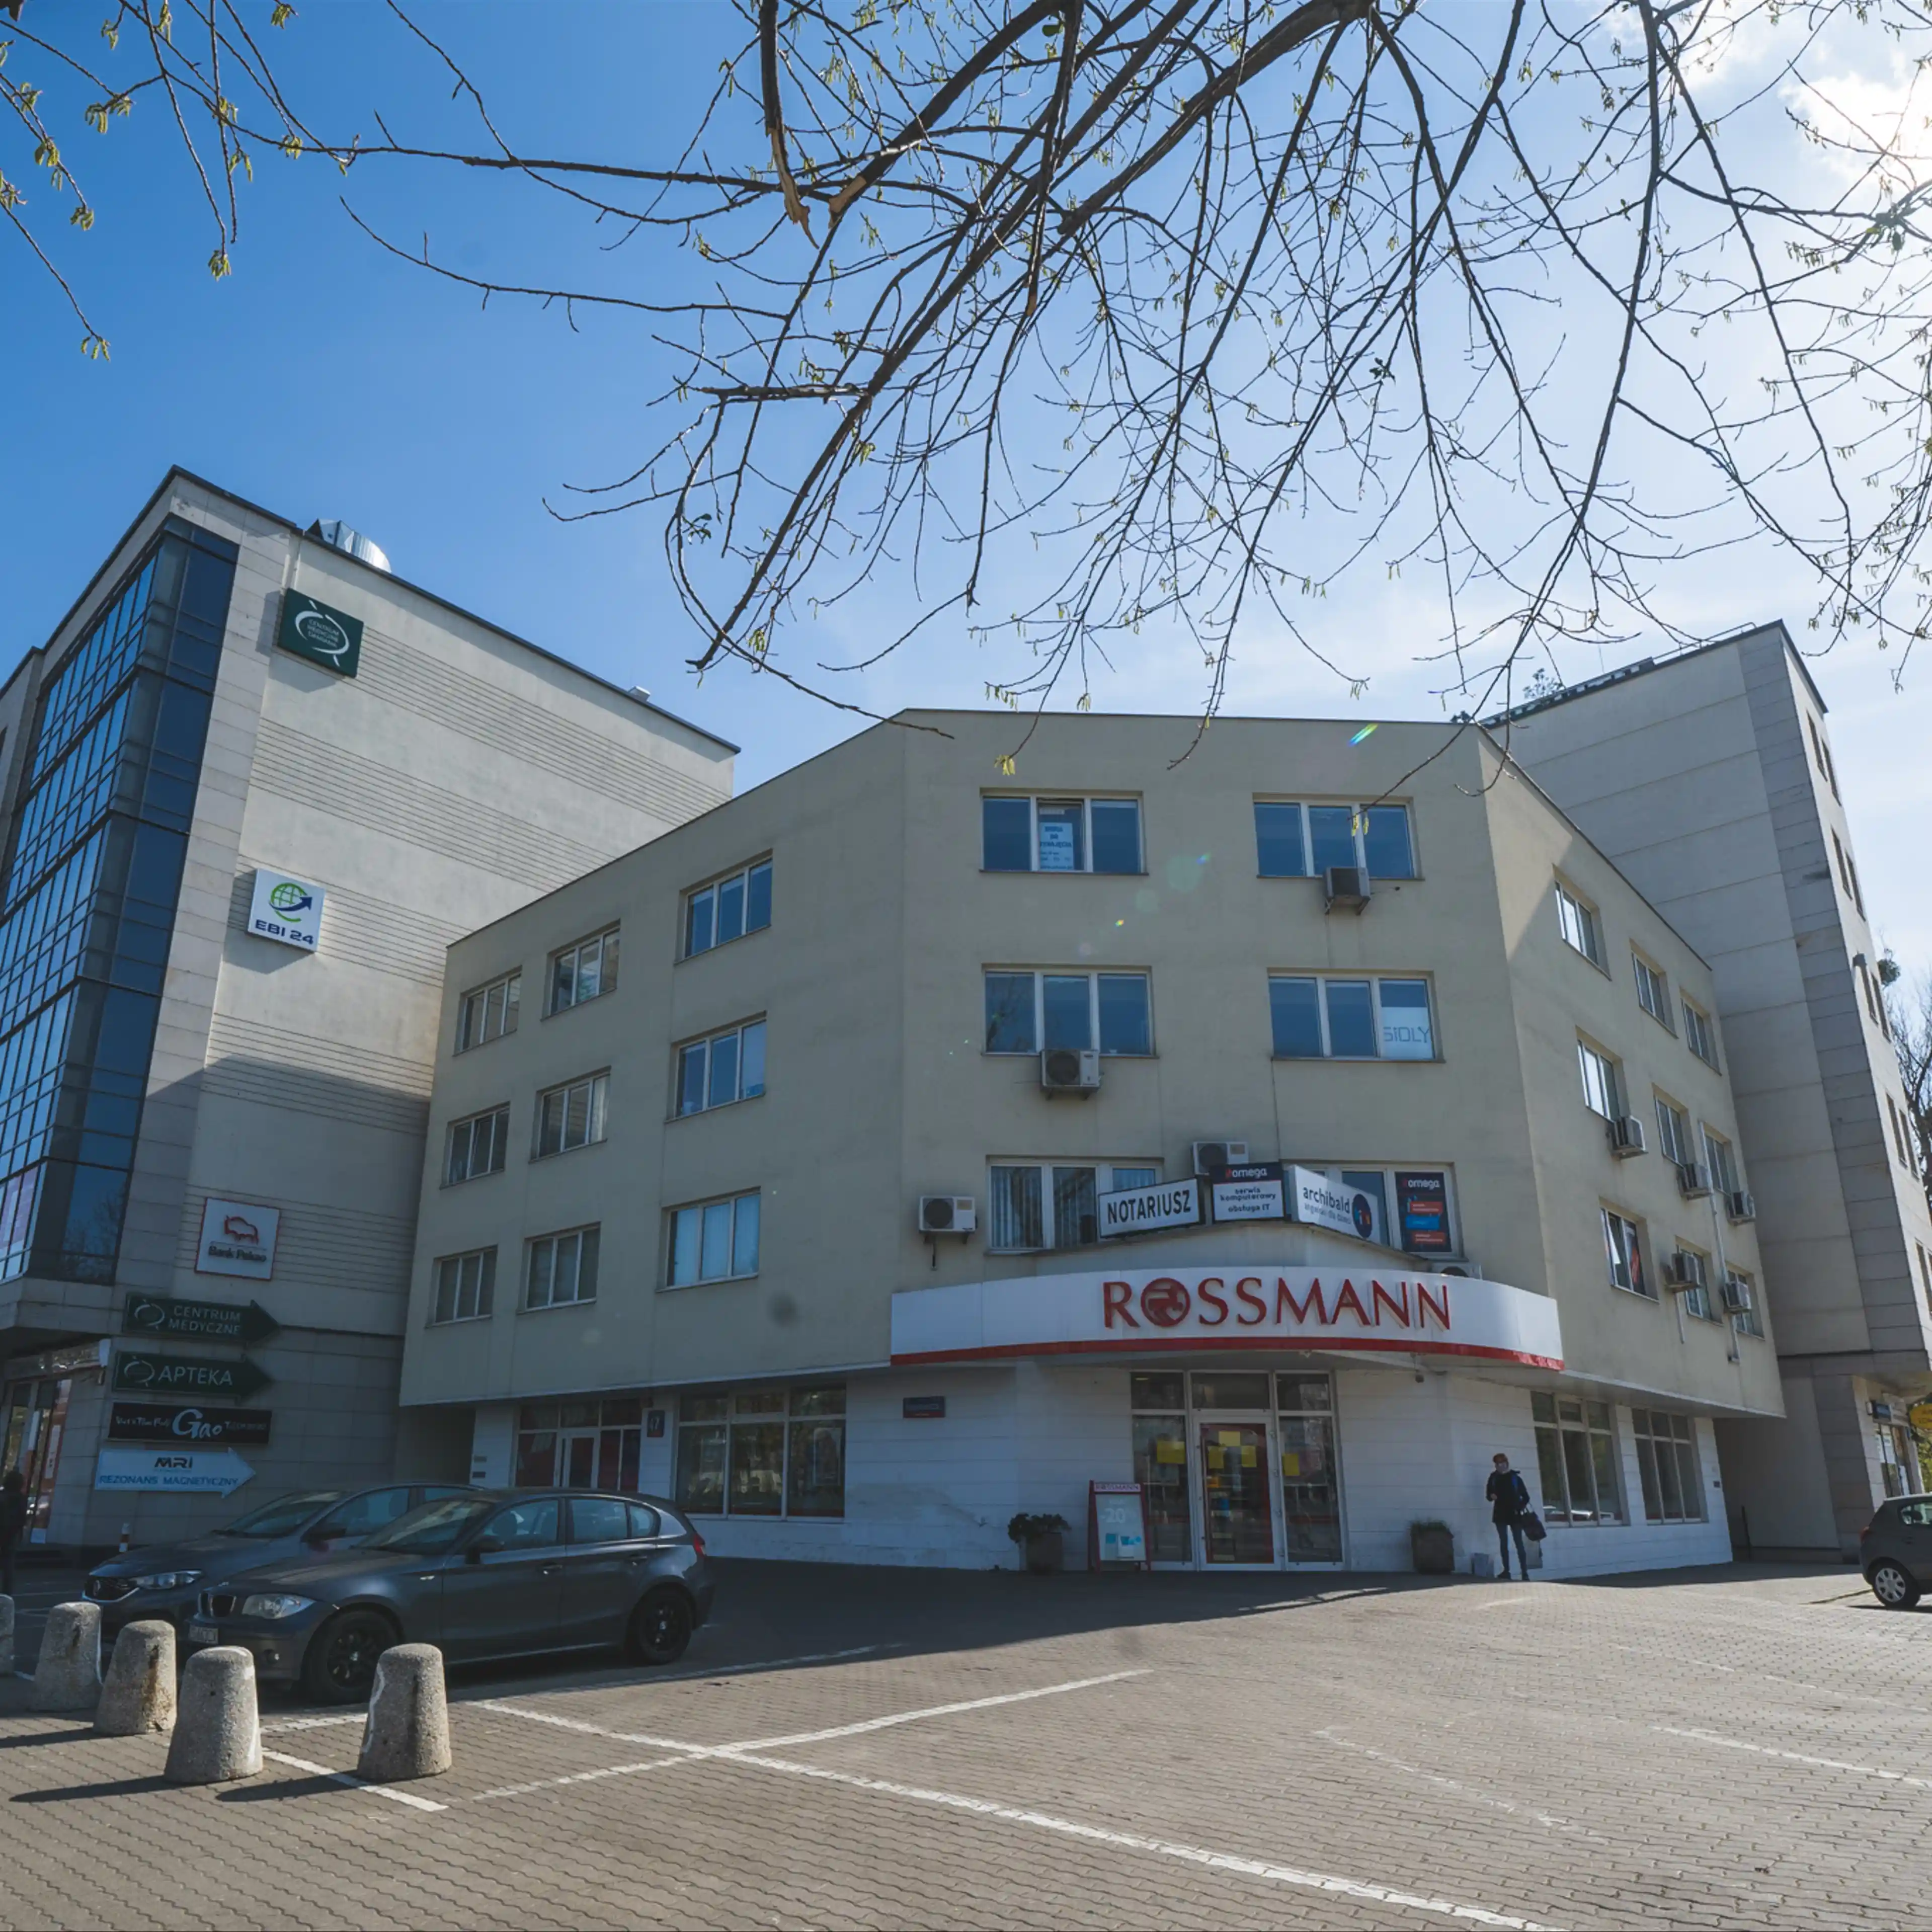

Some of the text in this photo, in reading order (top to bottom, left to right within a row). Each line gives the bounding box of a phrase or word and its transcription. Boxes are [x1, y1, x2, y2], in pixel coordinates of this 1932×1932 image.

[255, 919, 314, 945] EBI 24
[1232, 1168, 1268, 1179] omega
[1408, 1179, 1440, 1190] omega
[1107, 1189, 1192, 1224] NOTARIUSZ
[1302, 1186, 1350, 1214] archibald
[208, 1245, 234, 1259] Bank
[1103, 1277, 1451, 1330] ROSSMANN
[173, 1305, 242, 1322] CENTRUM
[168, 1318, 242, 1335] MEDYCZNE
[158, 1364, 233, 1386] APTEKA
[172, 1408, 223, 1439] Gao
[99, 1475, 239, 1487] REZONANS MAGNETYCZNY
